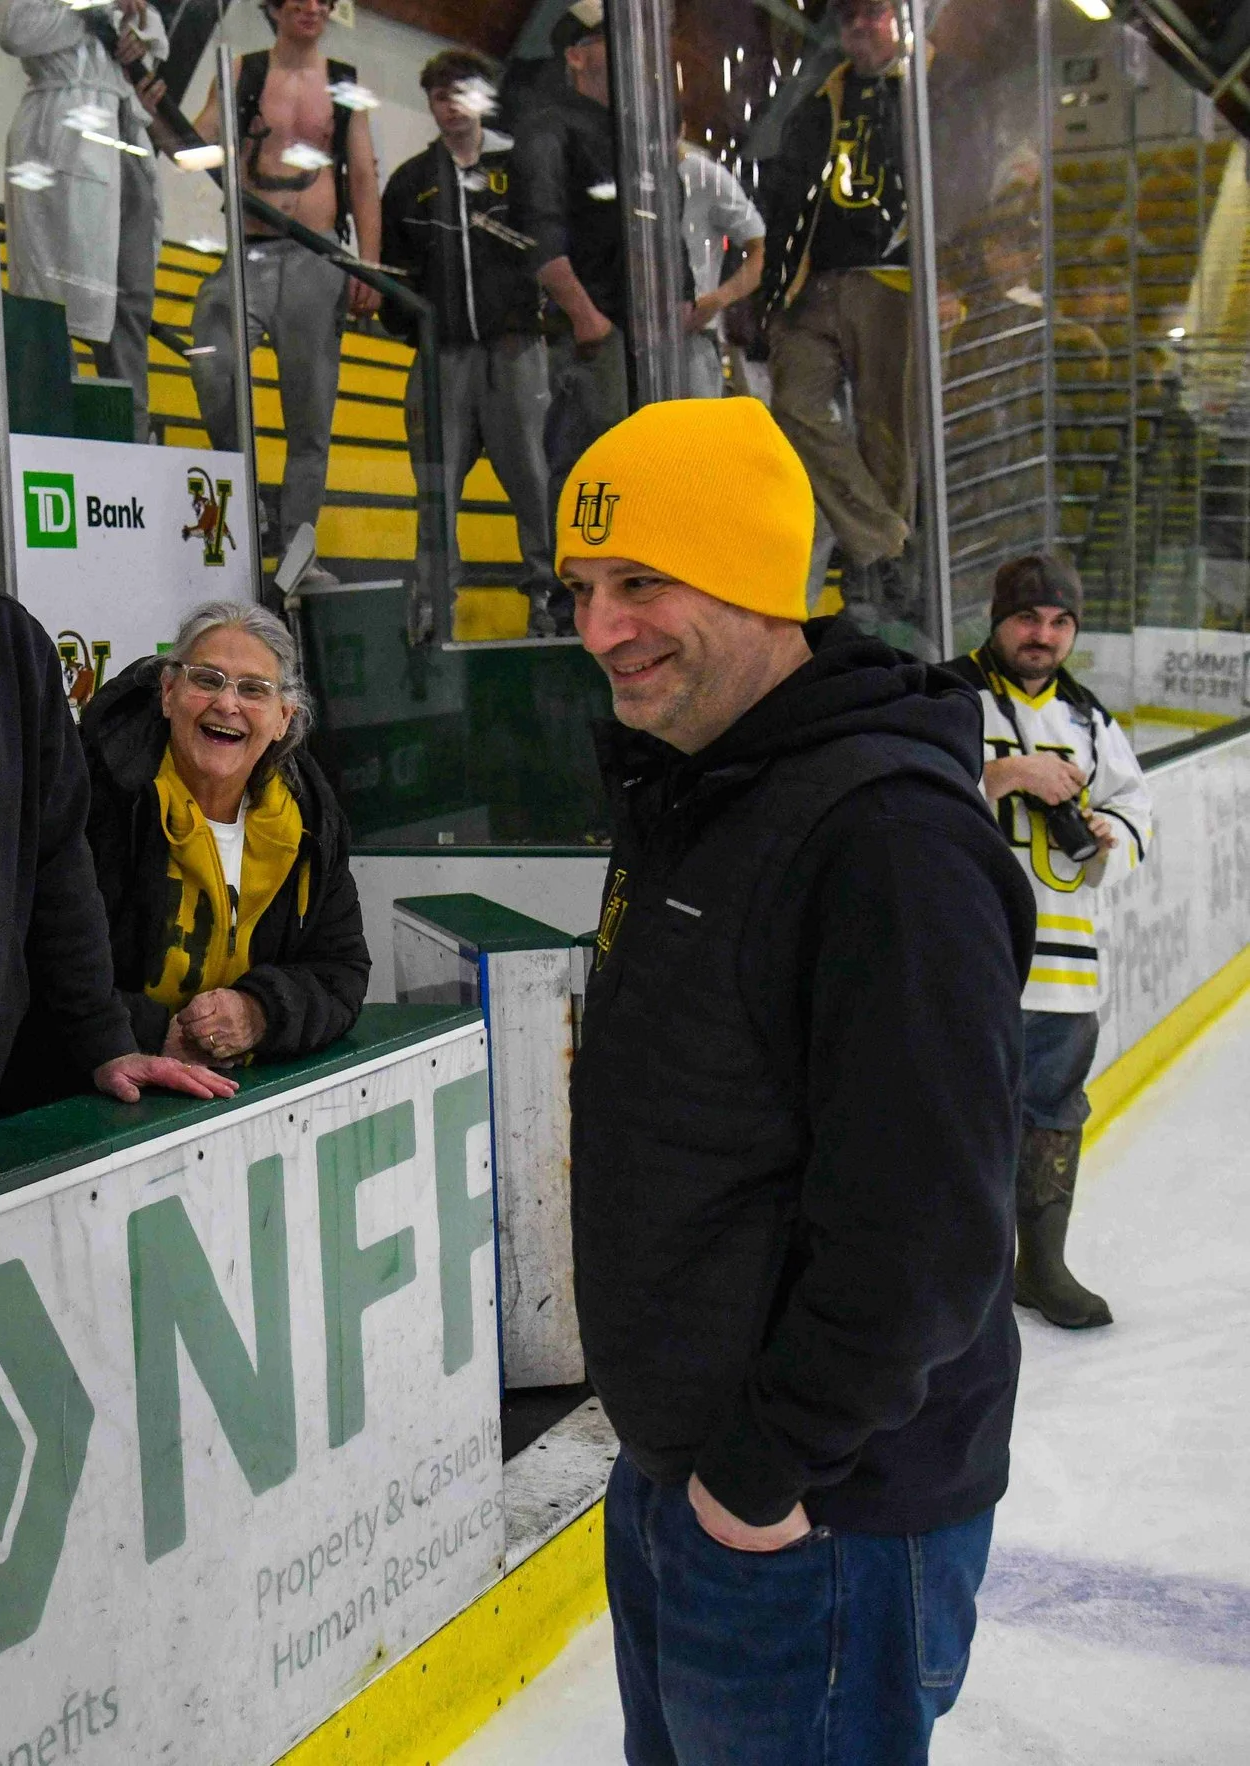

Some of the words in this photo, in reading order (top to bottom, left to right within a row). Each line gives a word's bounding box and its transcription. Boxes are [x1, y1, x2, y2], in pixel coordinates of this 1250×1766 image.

[29, 486, 71, 533] TD
[86, 495, 146, 529] Bank
[570, 480, 621, 546] HU
[256, 1504, 380, 1620] Property
[385, 1479, 406, 1526] &
[272, 1585, 377, 1689] Human
[383, 1490, 504, 1607] Resources
